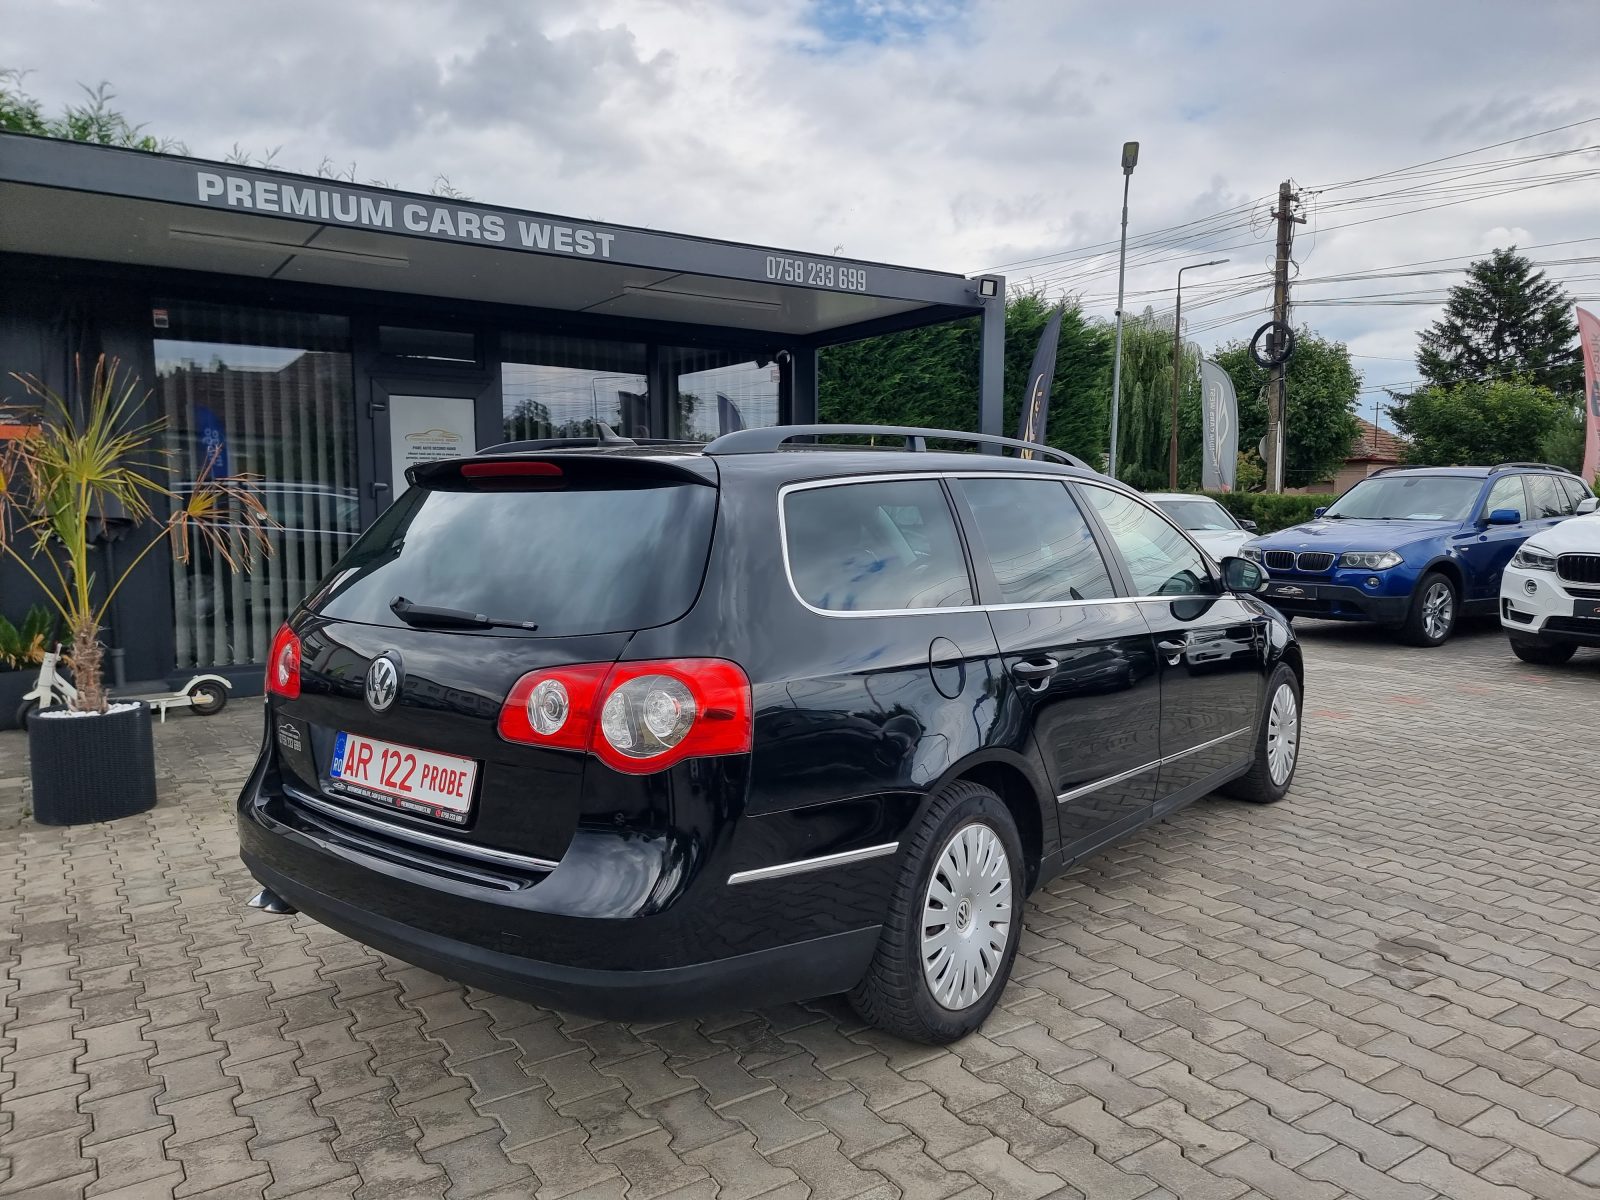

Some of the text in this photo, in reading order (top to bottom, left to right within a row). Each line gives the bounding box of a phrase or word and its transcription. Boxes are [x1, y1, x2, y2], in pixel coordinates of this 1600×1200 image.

[197, 171, 615, 258] PREMIUM CARS WEST
[766, 256, 866, 292] 0758 233 699
[332, 757, 343, 773] RO
[343, 740, 374, 781] AR
[380, 748, 417, 792] 122
[420, 763, 468, 798] PROBE
